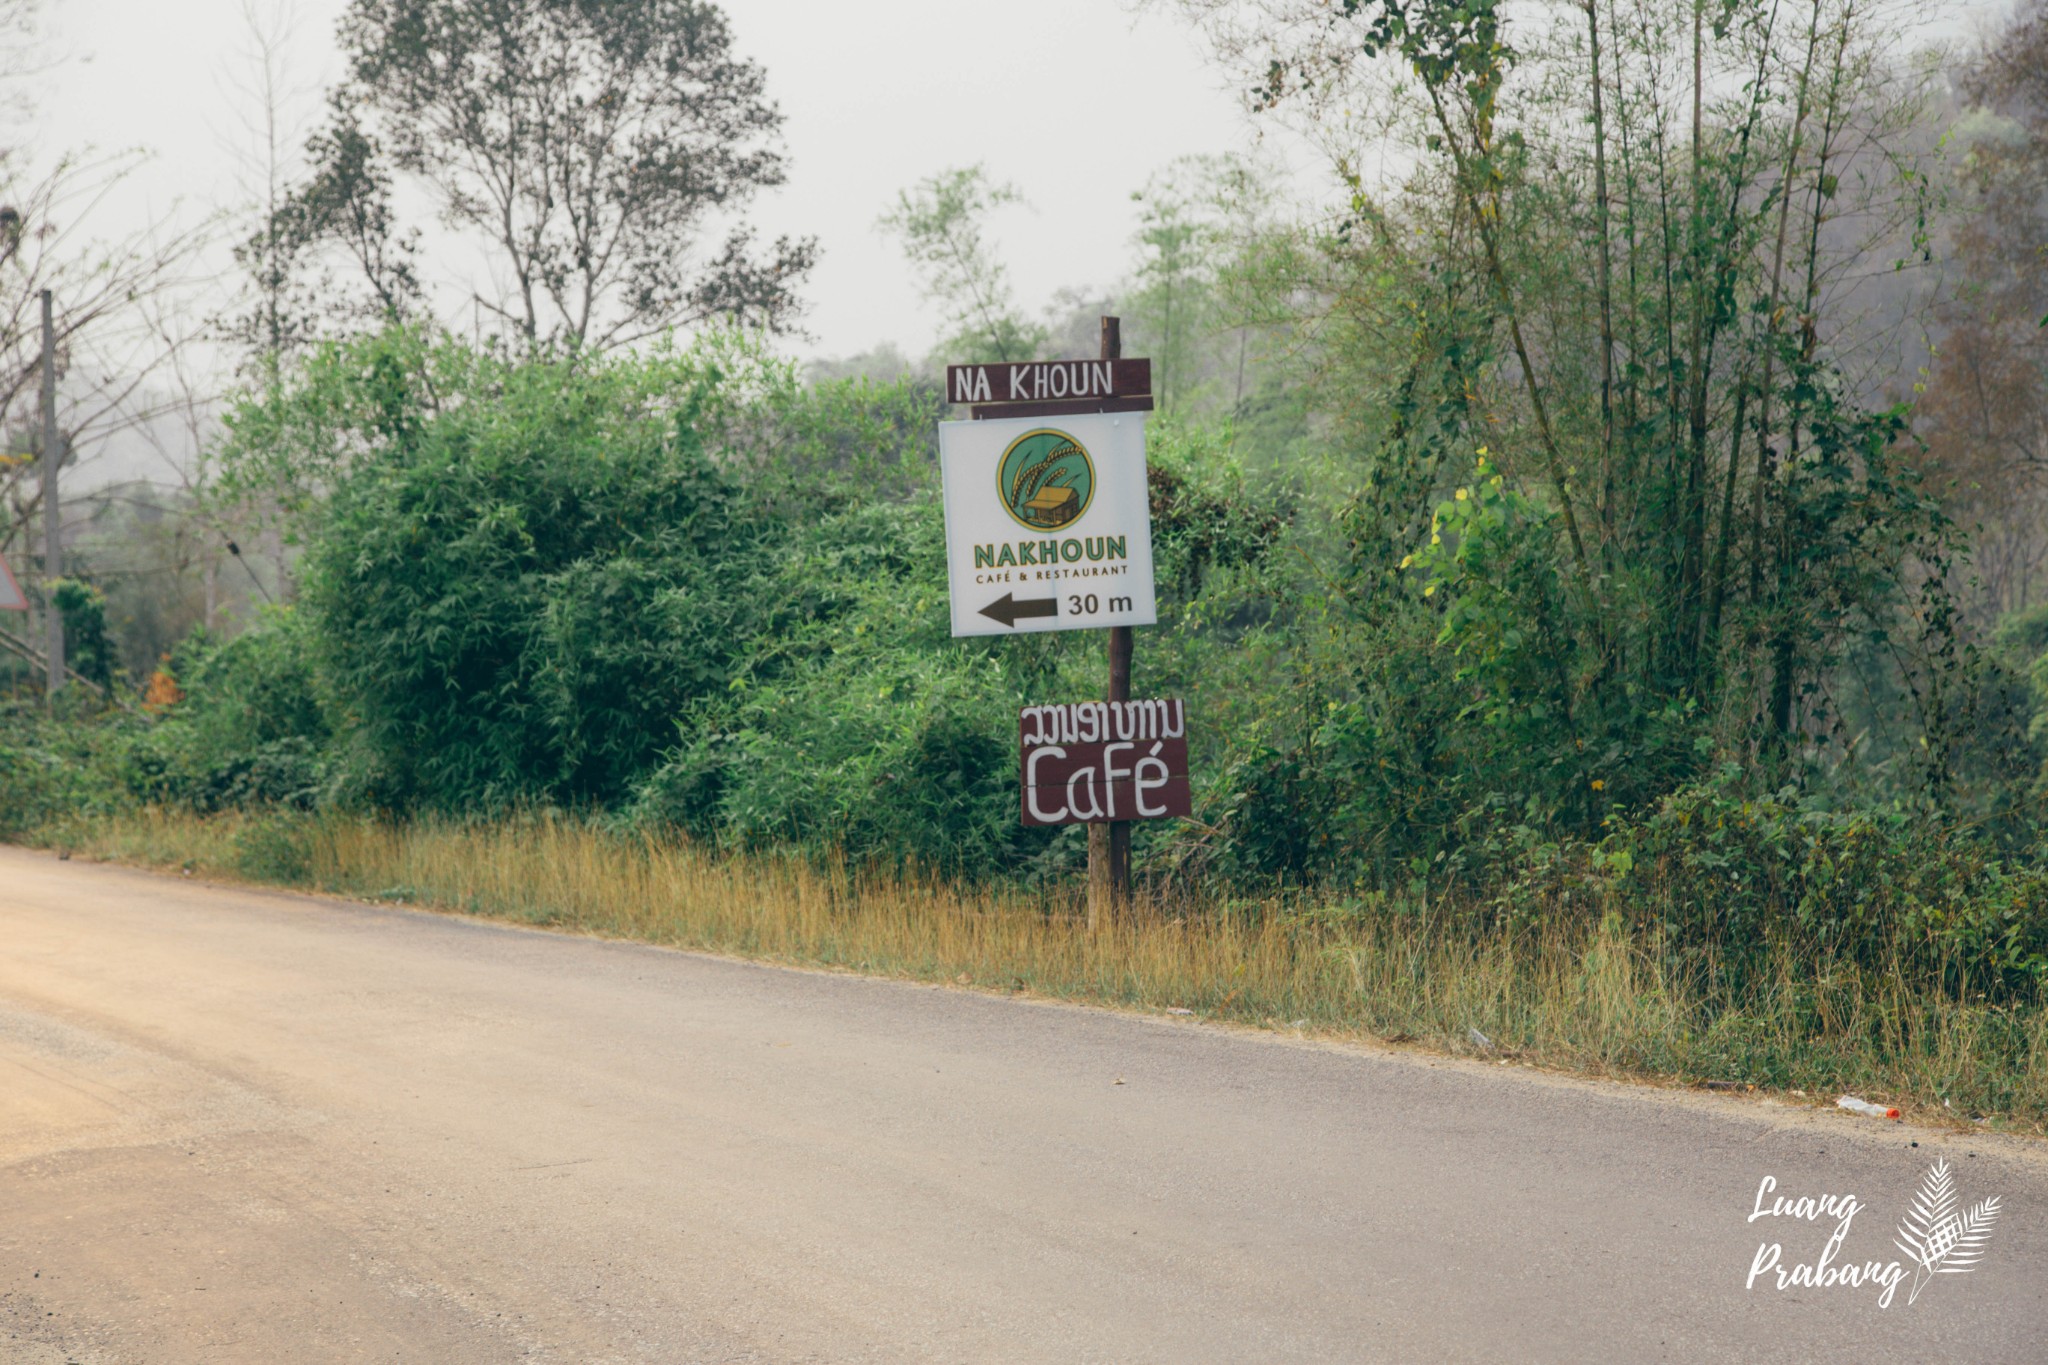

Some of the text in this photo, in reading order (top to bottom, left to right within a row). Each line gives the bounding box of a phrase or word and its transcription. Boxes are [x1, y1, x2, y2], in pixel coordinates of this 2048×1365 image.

[955, 361, 1113, 401] NA KHOUN
[974, 535, 1127, 569] NAKHOUN
[976, 565, 1128, 584] CAFÉ & RESTAURANT
[1068, 594, 1133, 616] 30 m
